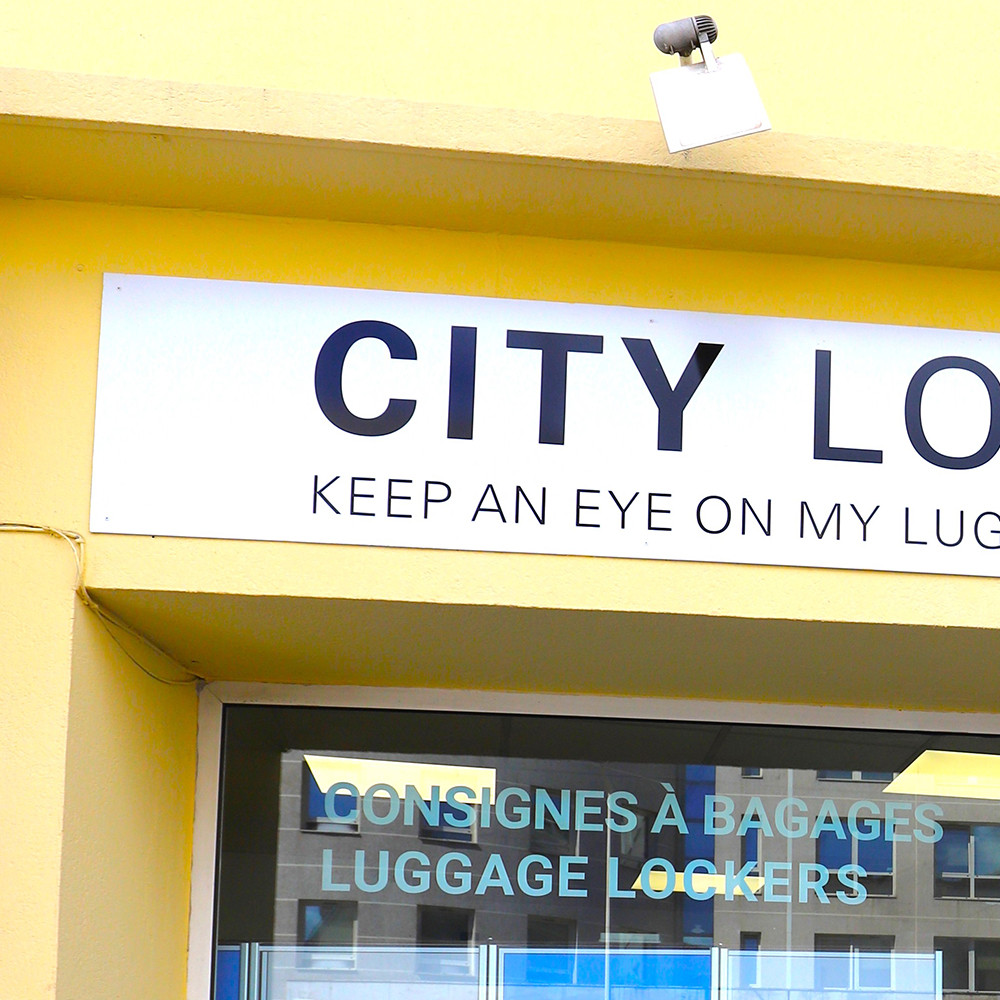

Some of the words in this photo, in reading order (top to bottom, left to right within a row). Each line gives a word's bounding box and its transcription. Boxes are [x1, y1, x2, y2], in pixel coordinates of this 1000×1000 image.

[314, 319, 725, 452] CITY
[312, 475, 452, 520] KEEP
[471, 484, 547, 526] AN
[575, 489, 672, 532] EYE
[696, 495, 772, 537] ON
[800, 501, 881, 544] MY
[323, 781, 638, 833] CONSIGNES
[650, 782, 690, 836] À
[705, 794, 945, 844] BAGAGES
[322, 848, 589, 899] LUGGAGE
[610, 856, 868, 906] LOCKERS
